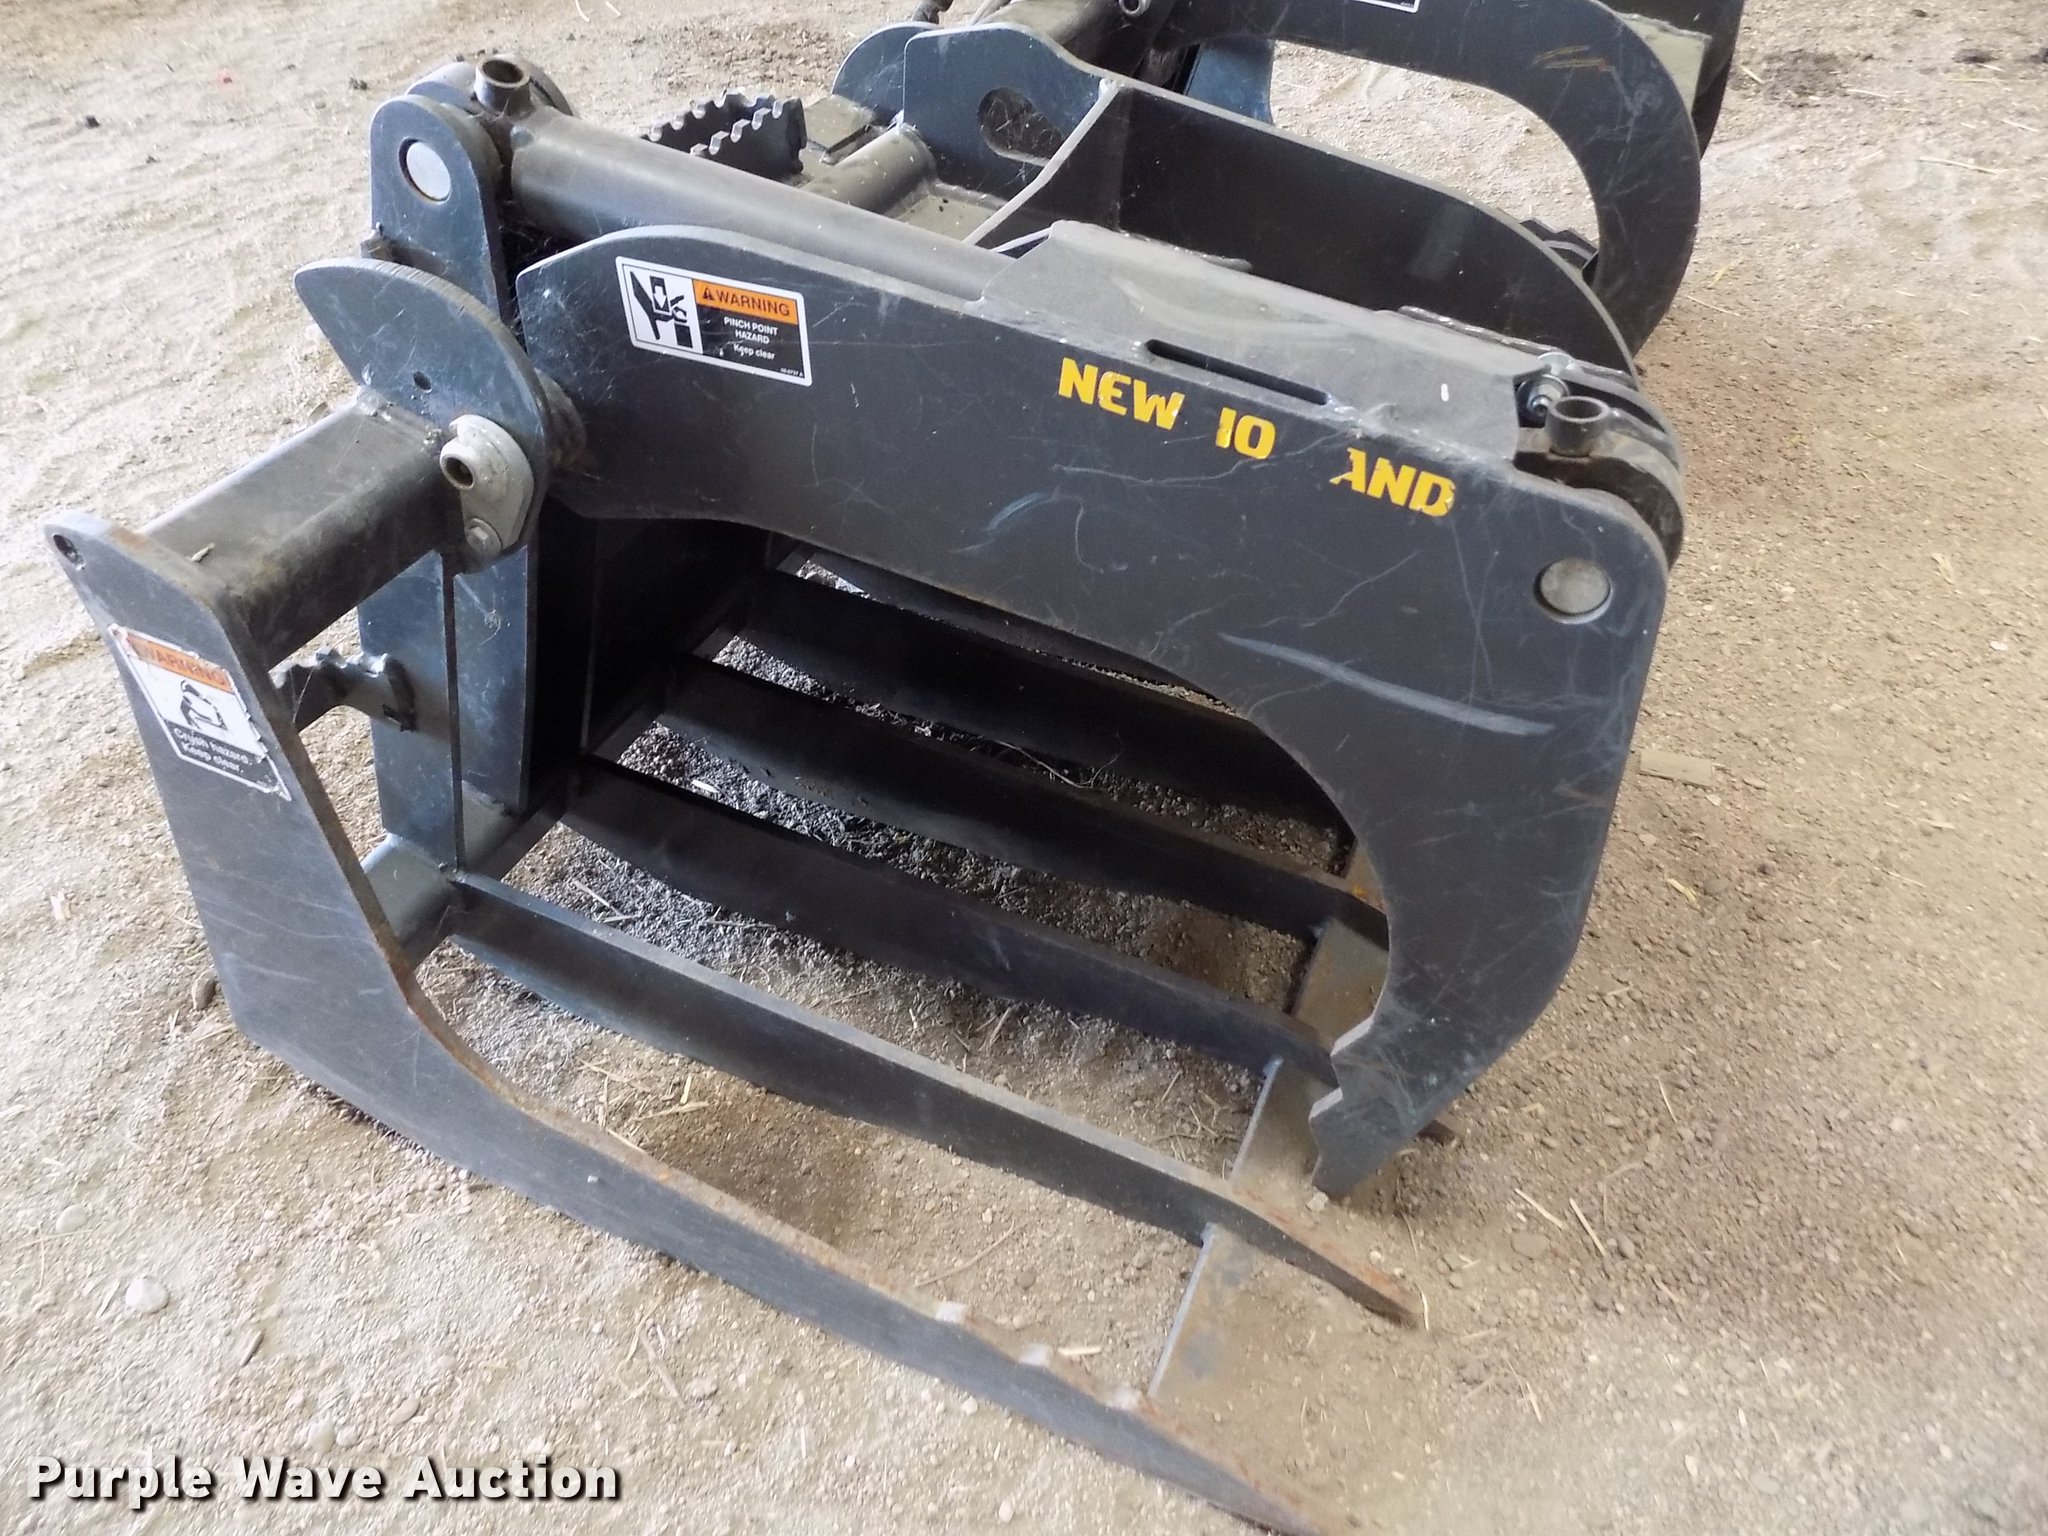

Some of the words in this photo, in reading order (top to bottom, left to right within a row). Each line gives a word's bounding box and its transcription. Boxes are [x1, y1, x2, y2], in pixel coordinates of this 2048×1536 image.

[715, 290, 790, 316] WARNING
[723, 316, 751, 330] PINCH
[752, 322, 779, 336] POINT
[735, 329, 770, 345] HAZARD
[733, 343, 755, 357] Keep
[755, 348, 775, 360] clear
[1059, 357, 1185, 431] NEW
